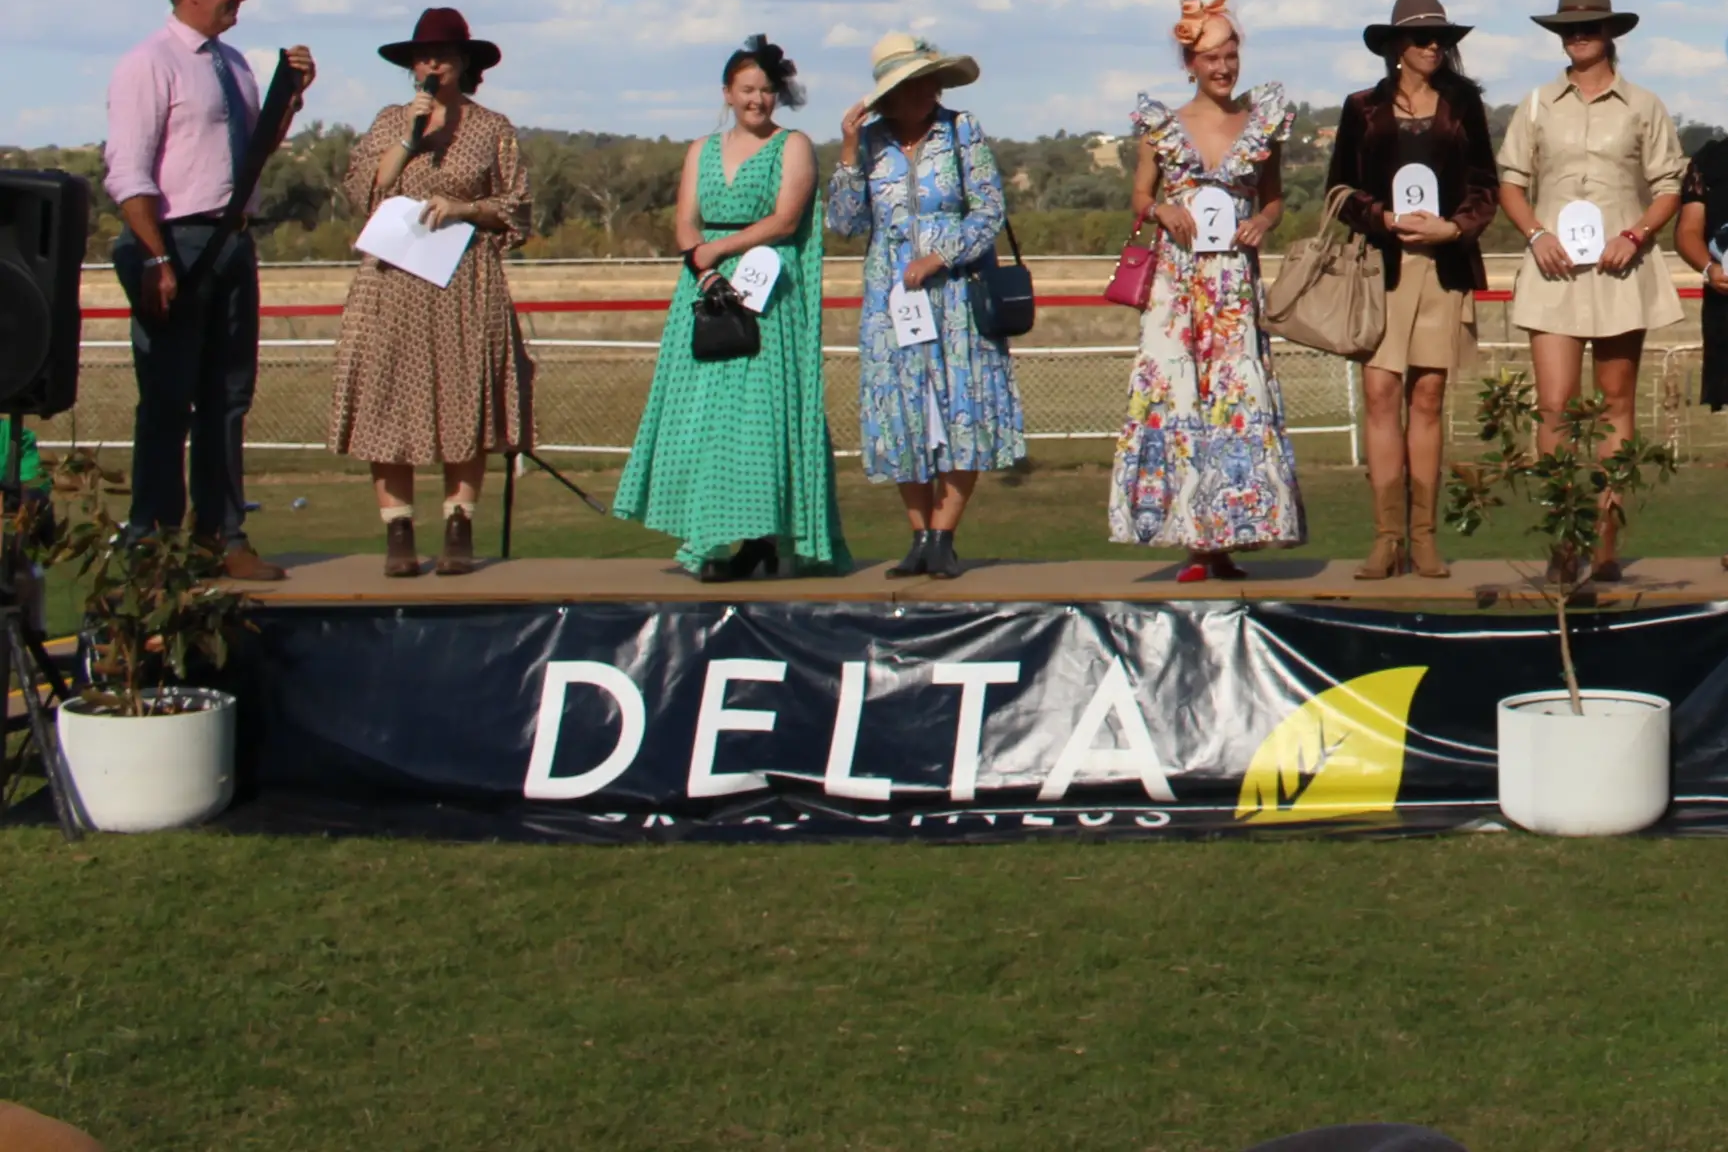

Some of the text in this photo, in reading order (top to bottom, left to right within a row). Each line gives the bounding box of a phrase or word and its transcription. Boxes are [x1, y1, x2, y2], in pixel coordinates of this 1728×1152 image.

[1405, 184, 1425, 205] 9
[1203, 207, 1220, 227] 7
[1570, 225, 1596, 241] 19
[740, 267, 769, 288] 29
[897, 304, 922, 321] 21
[524, 654, 1178, 801] DELTA
